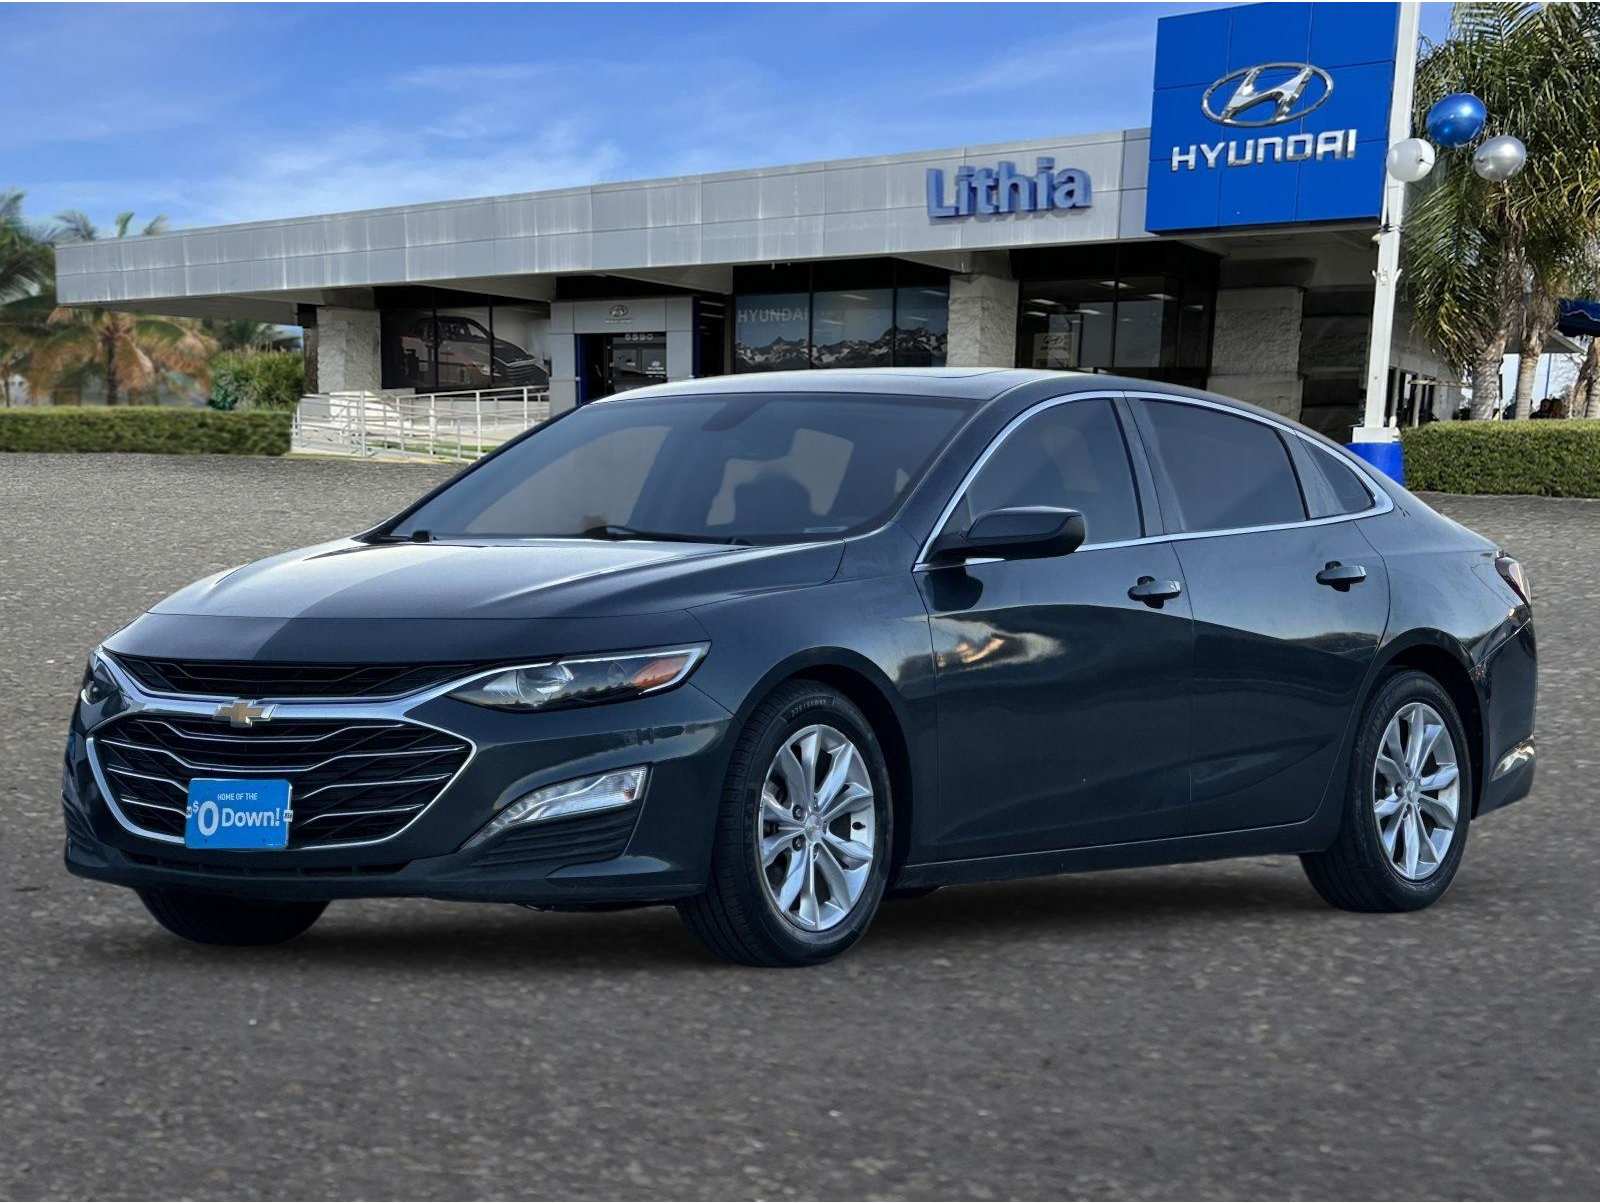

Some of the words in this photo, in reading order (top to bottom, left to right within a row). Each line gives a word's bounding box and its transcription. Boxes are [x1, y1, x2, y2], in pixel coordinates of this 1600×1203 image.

[1171, 129, 1357, 171] HYUNDAI
[926, 156, 1093, 218] Lithia
[737, 307, 809, 322] HYUNDAI
[217, 792, 235, 801] HOME
[235, 792, 244, 801] OF
[245, 792, 259, 801] THE
[221, 807, 280, 827] Down!
